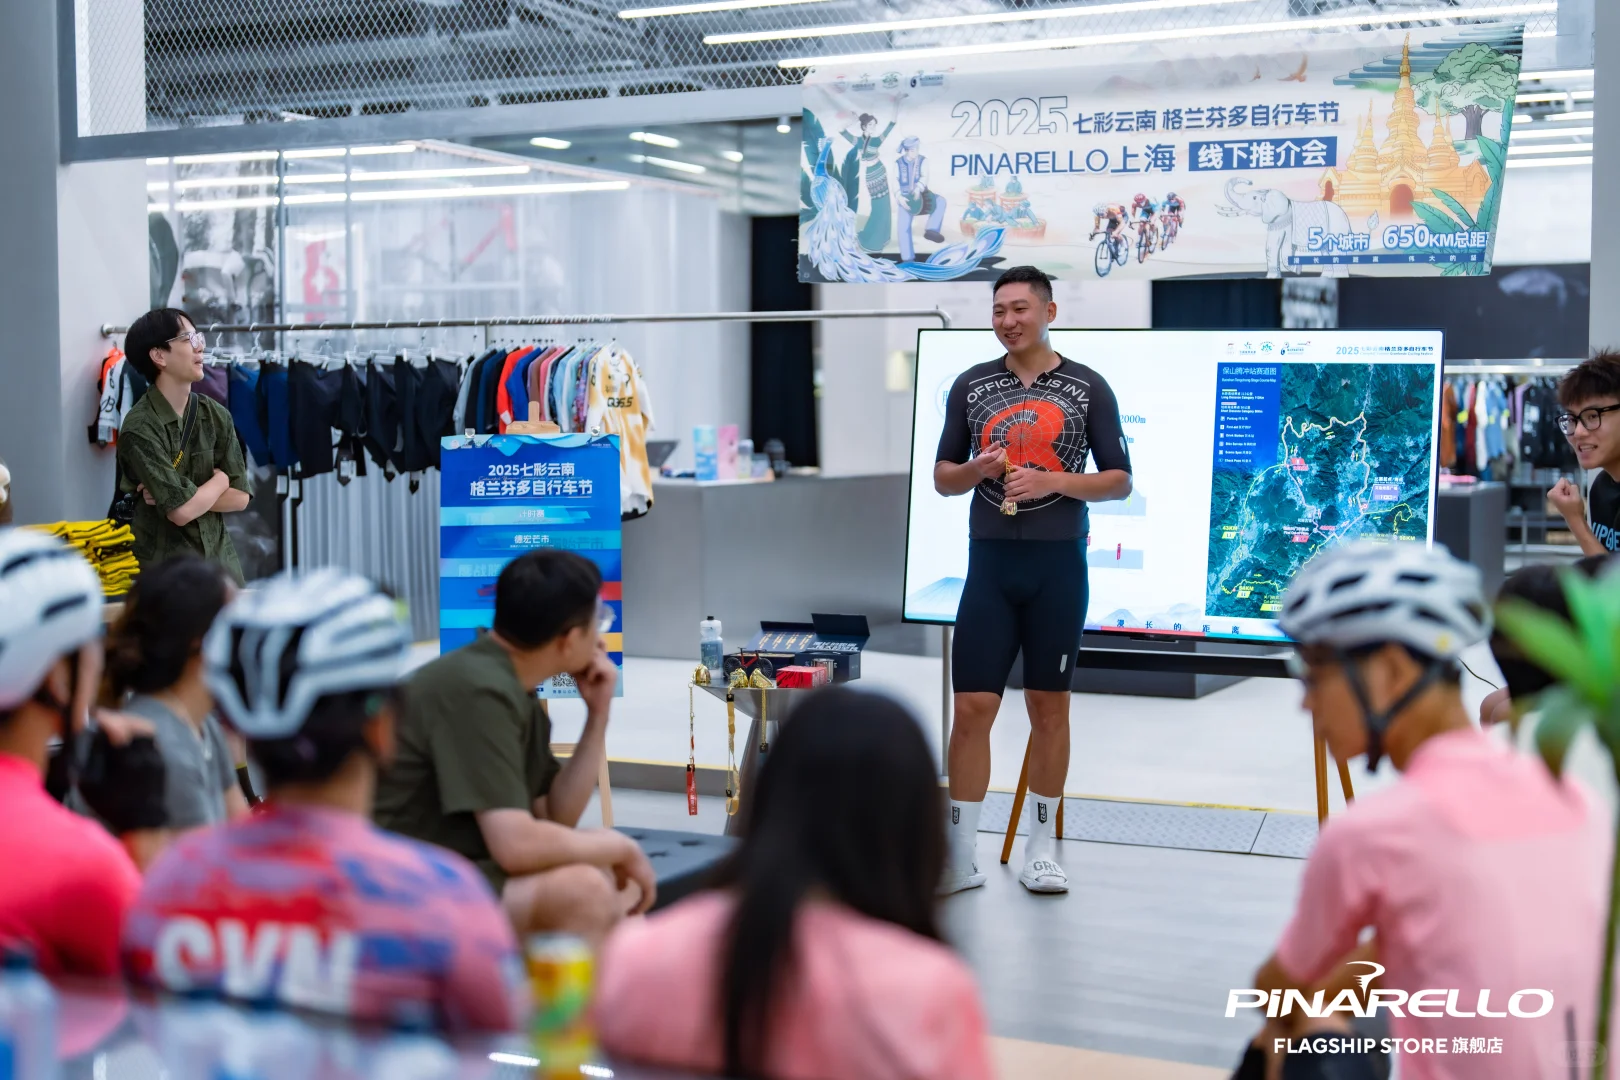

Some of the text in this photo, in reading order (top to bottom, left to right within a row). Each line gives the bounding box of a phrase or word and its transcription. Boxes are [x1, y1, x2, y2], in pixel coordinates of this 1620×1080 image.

[951, 95, 1340, 137] 2025 七彩云南 格兰芬多自行车节
[1197, 139, 1328, 170] 线下推介会
[1308, 225, 1489, 250] 5个城市 650KM总距
[1336, 346, 1359, 355] 2025
[488, 462, 575, 477] 2025七彩云南
[470, 479, 593, 496] 格兰芬多自行车节
[514, 534, 550, 544] 德宏芒市
[1116, 619, 1240, 635] 漫长的距离
